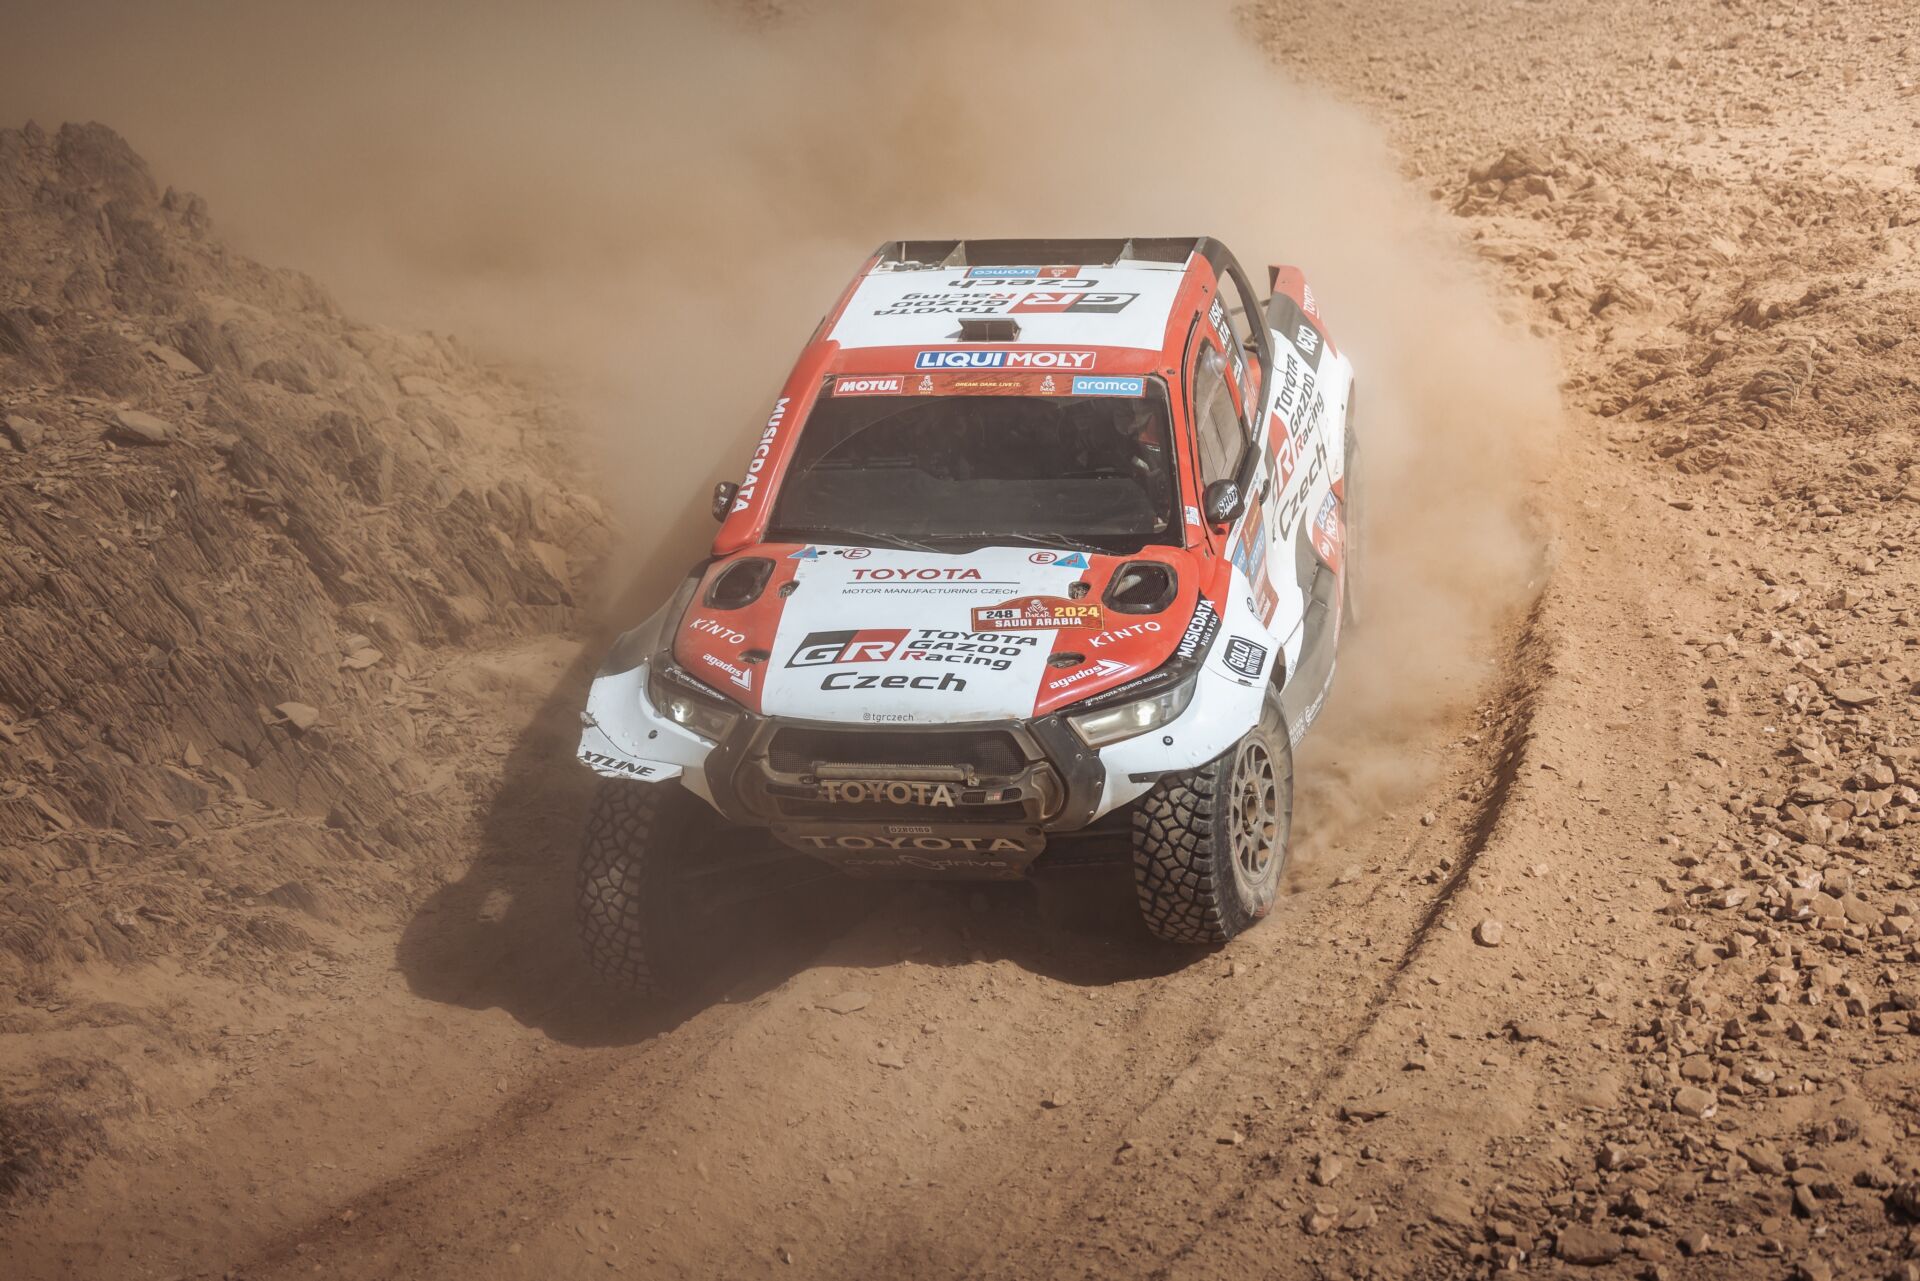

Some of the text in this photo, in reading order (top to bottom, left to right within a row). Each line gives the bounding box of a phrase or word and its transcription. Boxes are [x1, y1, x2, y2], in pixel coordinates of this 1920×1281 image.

[949, 279, 1100, 289] Czech
[974, 268, 1036, 276] aramco
[891, 299, 1009, 308] GAZOO
[902, 292, 1017, 301] Racing
[873, 307, 999, 316] TOYOTA
[1296, 324, 1319, 355] NEXO
[919, 352, 1093, 367] LIQUI MOLY
[839, 381, 899, 392] MOTUL
[1077, 380, 1139, 392] aramco
[1274, 353, 1298, 416] TOYOTA
[1290, 373, 1315, 438] GAZOO
[1295, 391, 1325, 458] Racing
[731, 397, 791, 513] MUSICDATA
[1279, 442, 1328, 542] Czech
[852, 568, 982, 580] TOYOTA
[986, 609, 1014, 619] 248
[1054, 607, 1100, 618] 2024
[995, 617, 1082, 628] SAUDI ARABIA
[1176, 598, 1216, 659] MUSICDATA
[1200, 632, 1212, 647] PLUG
[1208, 613, 1219, 629] PLAY
[788, 629, 1038, 668] GR TOYOTA
[900, 650, 1012, 671] Racing
[908, 640, 1022, 657] GAZOO
[1229, 641, 1249, 669] GOLD
[1244, 646, 1264, 675] NUTRITION
[703, 653, 742, 677] agados
[821, 671, 967, 692] Czech
[1049, 665, 1104, 690] agados
[1094, 672, 1169, 702] TOYOTA TSUSHO EUROPE
[580, 750, 656, 777] XTLINE
[821, 781, 955, 808] TOYOTA
[800, 835, 1027, 852] TOYOTA
